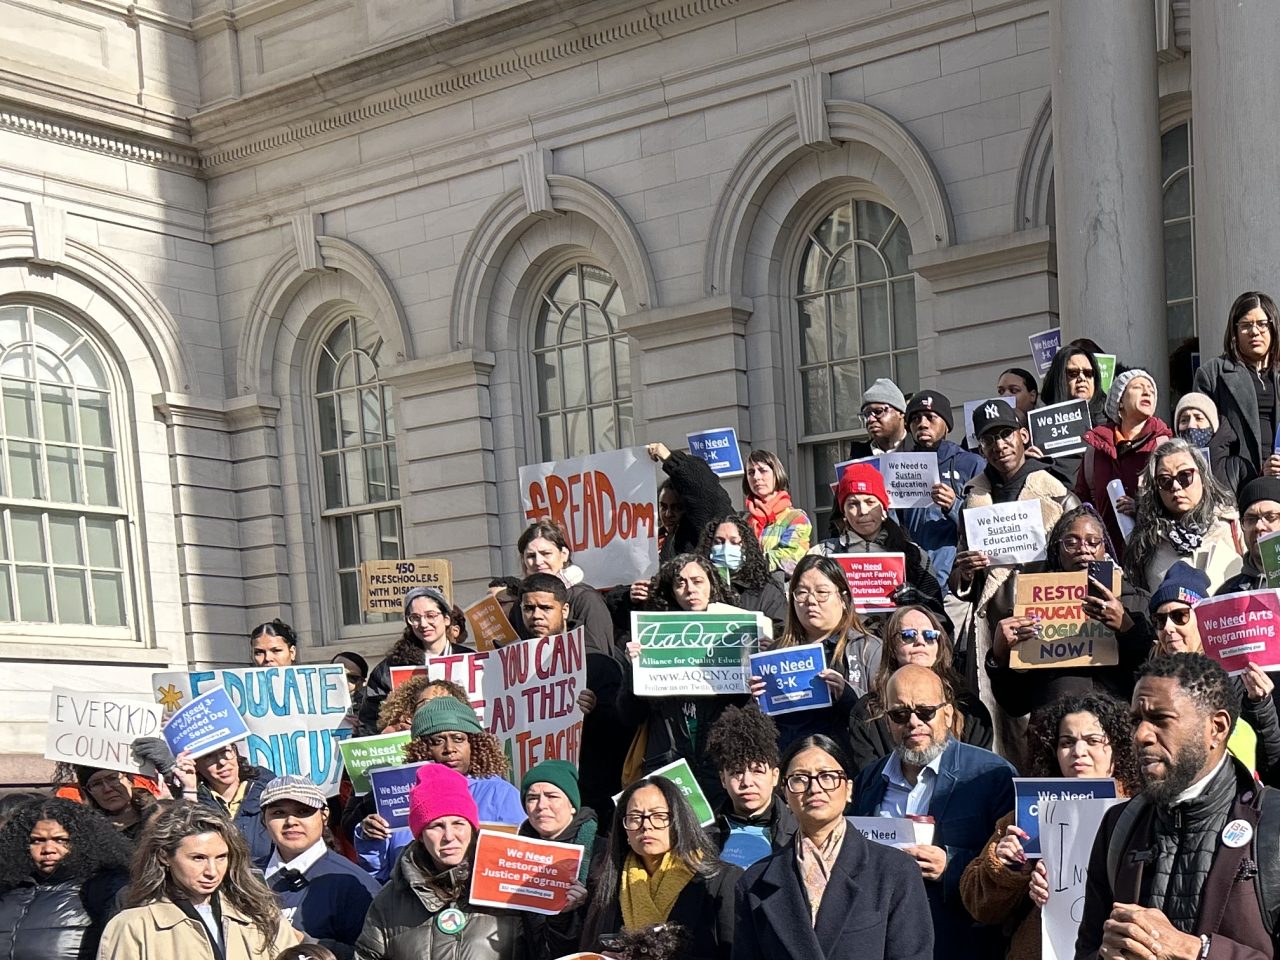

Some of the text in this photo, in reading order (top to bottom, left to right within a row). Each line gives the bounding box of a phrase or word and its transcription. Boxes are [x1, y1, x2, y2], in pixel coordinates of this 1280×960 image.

[1042, 337, 1059, 349] Need
[985, 404, 1000, 419] NY
[1036, 408, 1083, 427] We Need
[1051, 425, 1069, 438] 3-K
[692, 436, 730, 450] We Need
[704, 450, 718, 460] 3-K
[888, 462, 928, 470] We Need to
[896, 472, 922, 480] Sustain
[977, 512, 1028, 526] We Need to
[988, 523, 1022, 536] Sustain
[983, 533, 1029, 546] Education
[978, 542, 1039, 556] rogramming
[395, 563, 415, 574] 450
[370, 574, 439, 584] PRESCHOOLERS
[369, 587, 389, 596] WITH
[370, 599, 402, 608] SITTING
[1204, 610, 1274, 631] We Need Arts
[1207, 625, 1276, 645] Programming
[429, 652, 489, 693] IF
[498, 642, 530, 690] YOU
[535, 628, 582, 680] CAN
[642, 656, 715, 665] Alliance for Quality
[759, 656, 816, 676] We Need
[775, 676, 798, 690] 3-K
[521, 677, 577, 722] THIS
[211, 709, 228, 721] Day
[189, 724, 214, 739] Seats
[352, 744, 397, 758] We Need
[351, 757, 386, 768] Mental
[380, 783, 410, 794] We Need
[380, 797, 404, 806] Impact
[1037, 790, 1095, 801] We Need
[871, 830, 897, 840] Need
[507, 848, 554, 864] We Need
[498, 858, 558, 876] Restorative
[482, 868, 571, 889] Justice Programs
